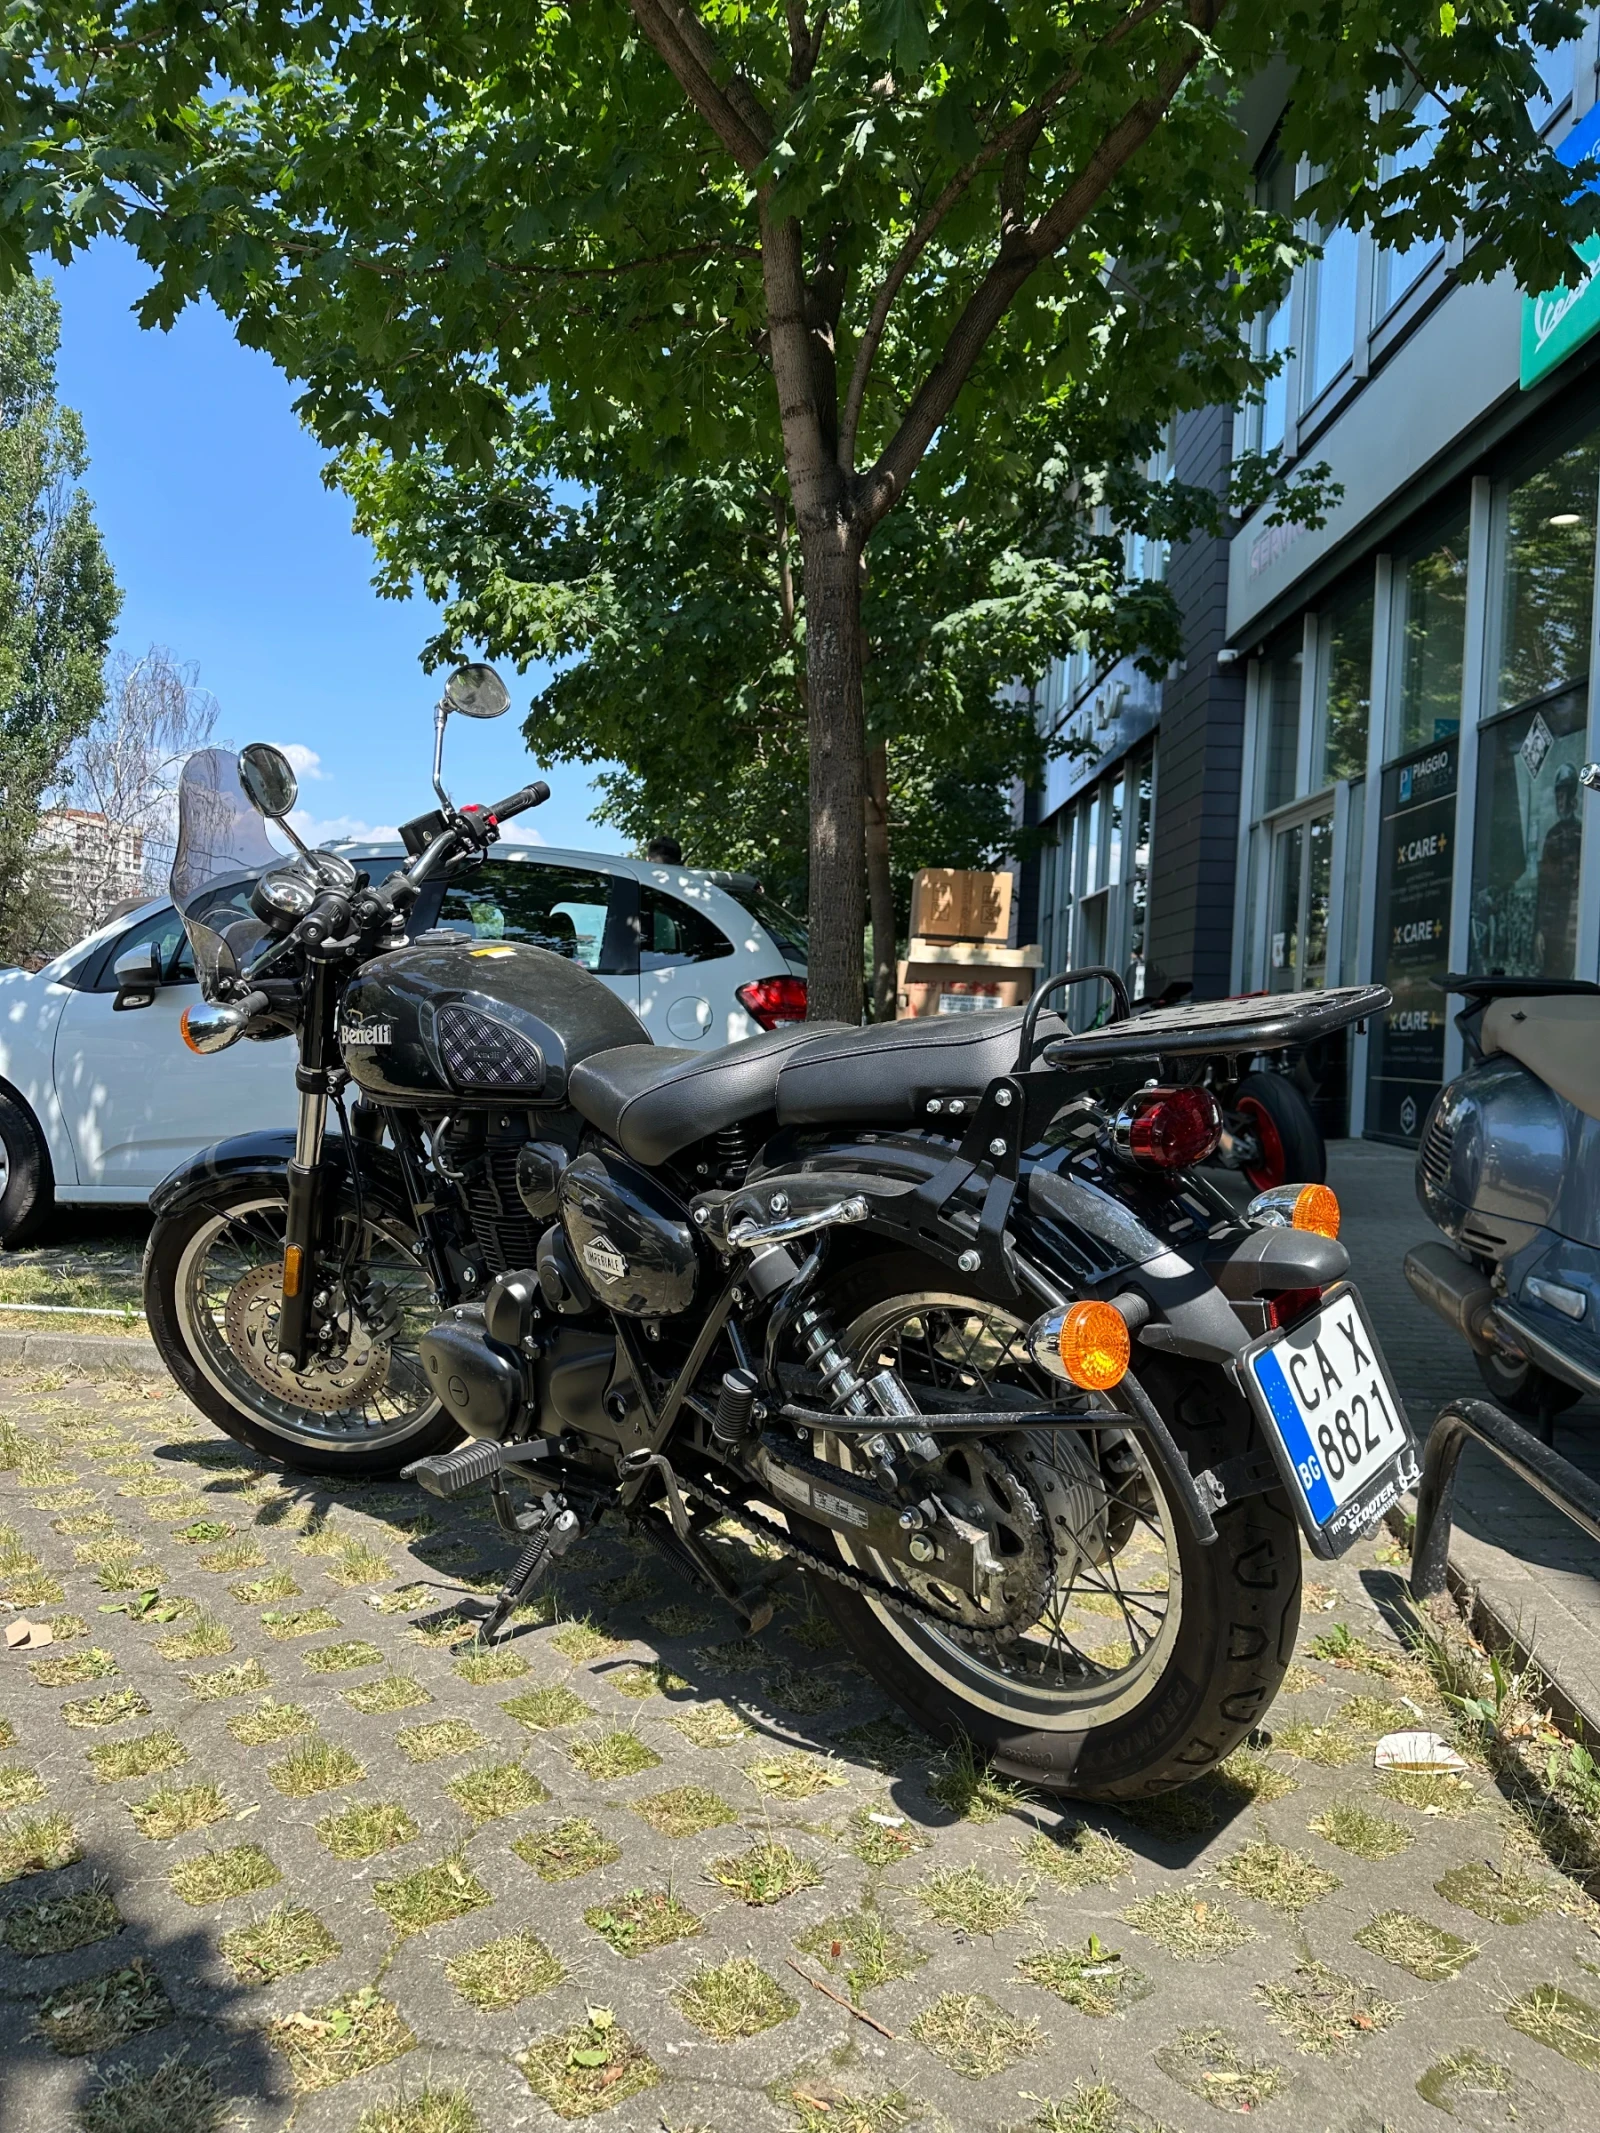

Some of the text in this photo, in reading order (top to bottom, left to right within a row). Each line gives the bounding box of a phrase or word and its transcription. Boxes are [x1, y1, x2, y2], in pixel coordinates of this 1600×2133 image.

[1412, 750, 1449, 779] PIAGGIO
[341, 1024, 392, 1045] Benelli
[473, 1050, 500, 1059] Benelli
[587, 1249, 620, 1272] IMPERIALE
[1289, 1312, 1371, 1412] CA X
[1317, 1379, 1394, 1481] 8821
[1298, 1455, 1321, 1490] BG
[1331, 1503, 1360, 1535] moto
[1348, 1481, 1396, 1535] SCOOTER
